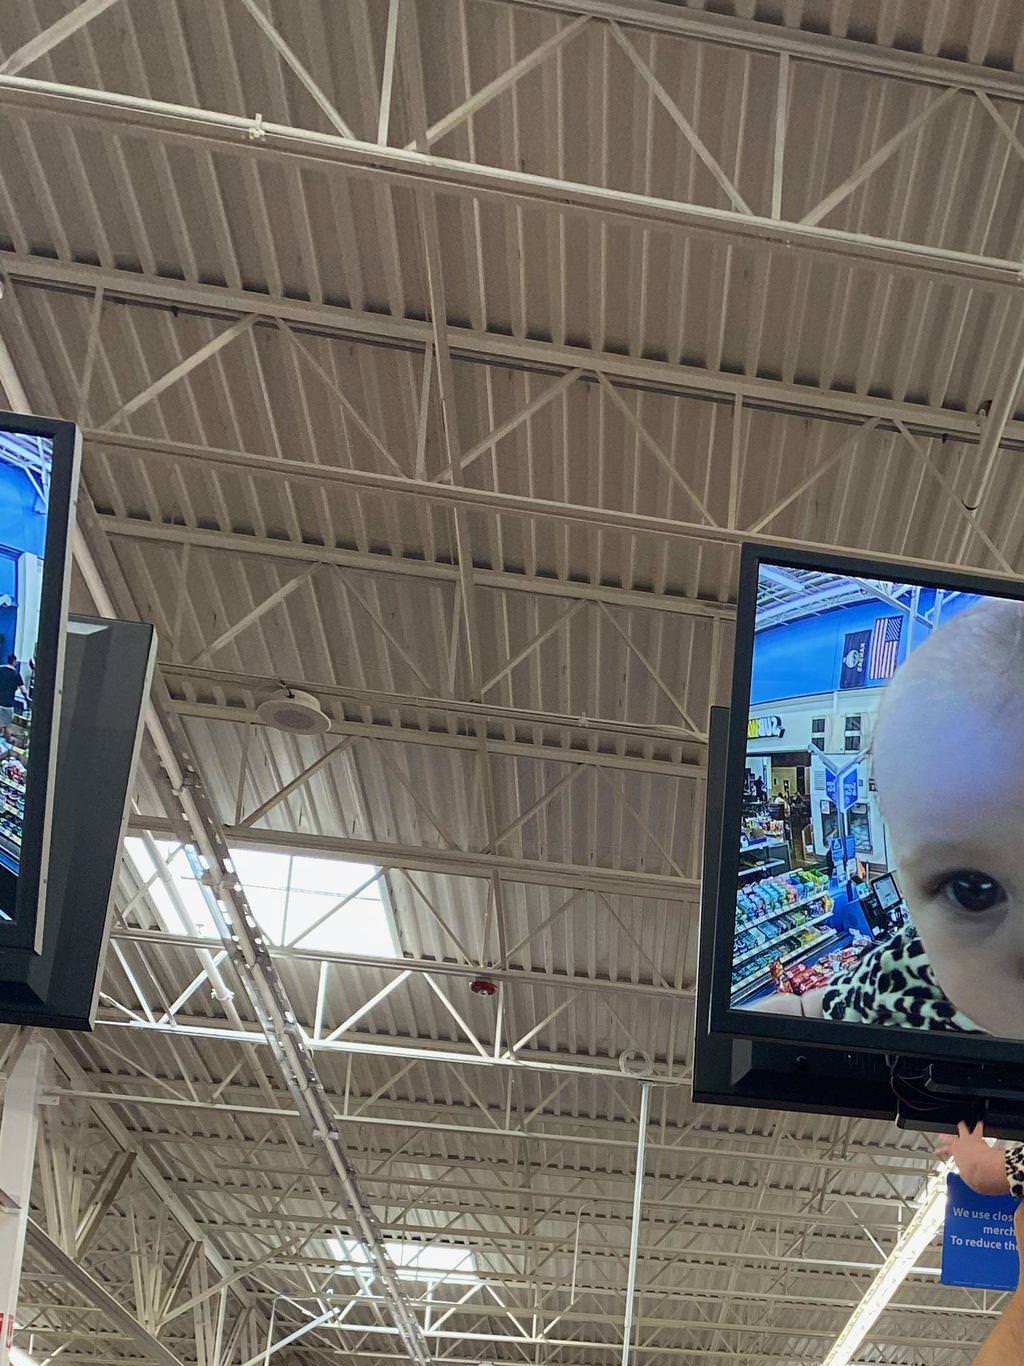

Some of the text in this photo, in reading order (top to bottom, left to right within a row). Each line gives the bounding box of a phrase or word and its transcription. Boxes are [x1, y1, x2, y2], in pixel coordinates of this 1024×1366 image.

[952, 1207, 970, 1218] We
[972, 1210, 991, 1219] use
[950, 1235, 963, 1246] To
[965, 1238, 1002, 1250] reduce
